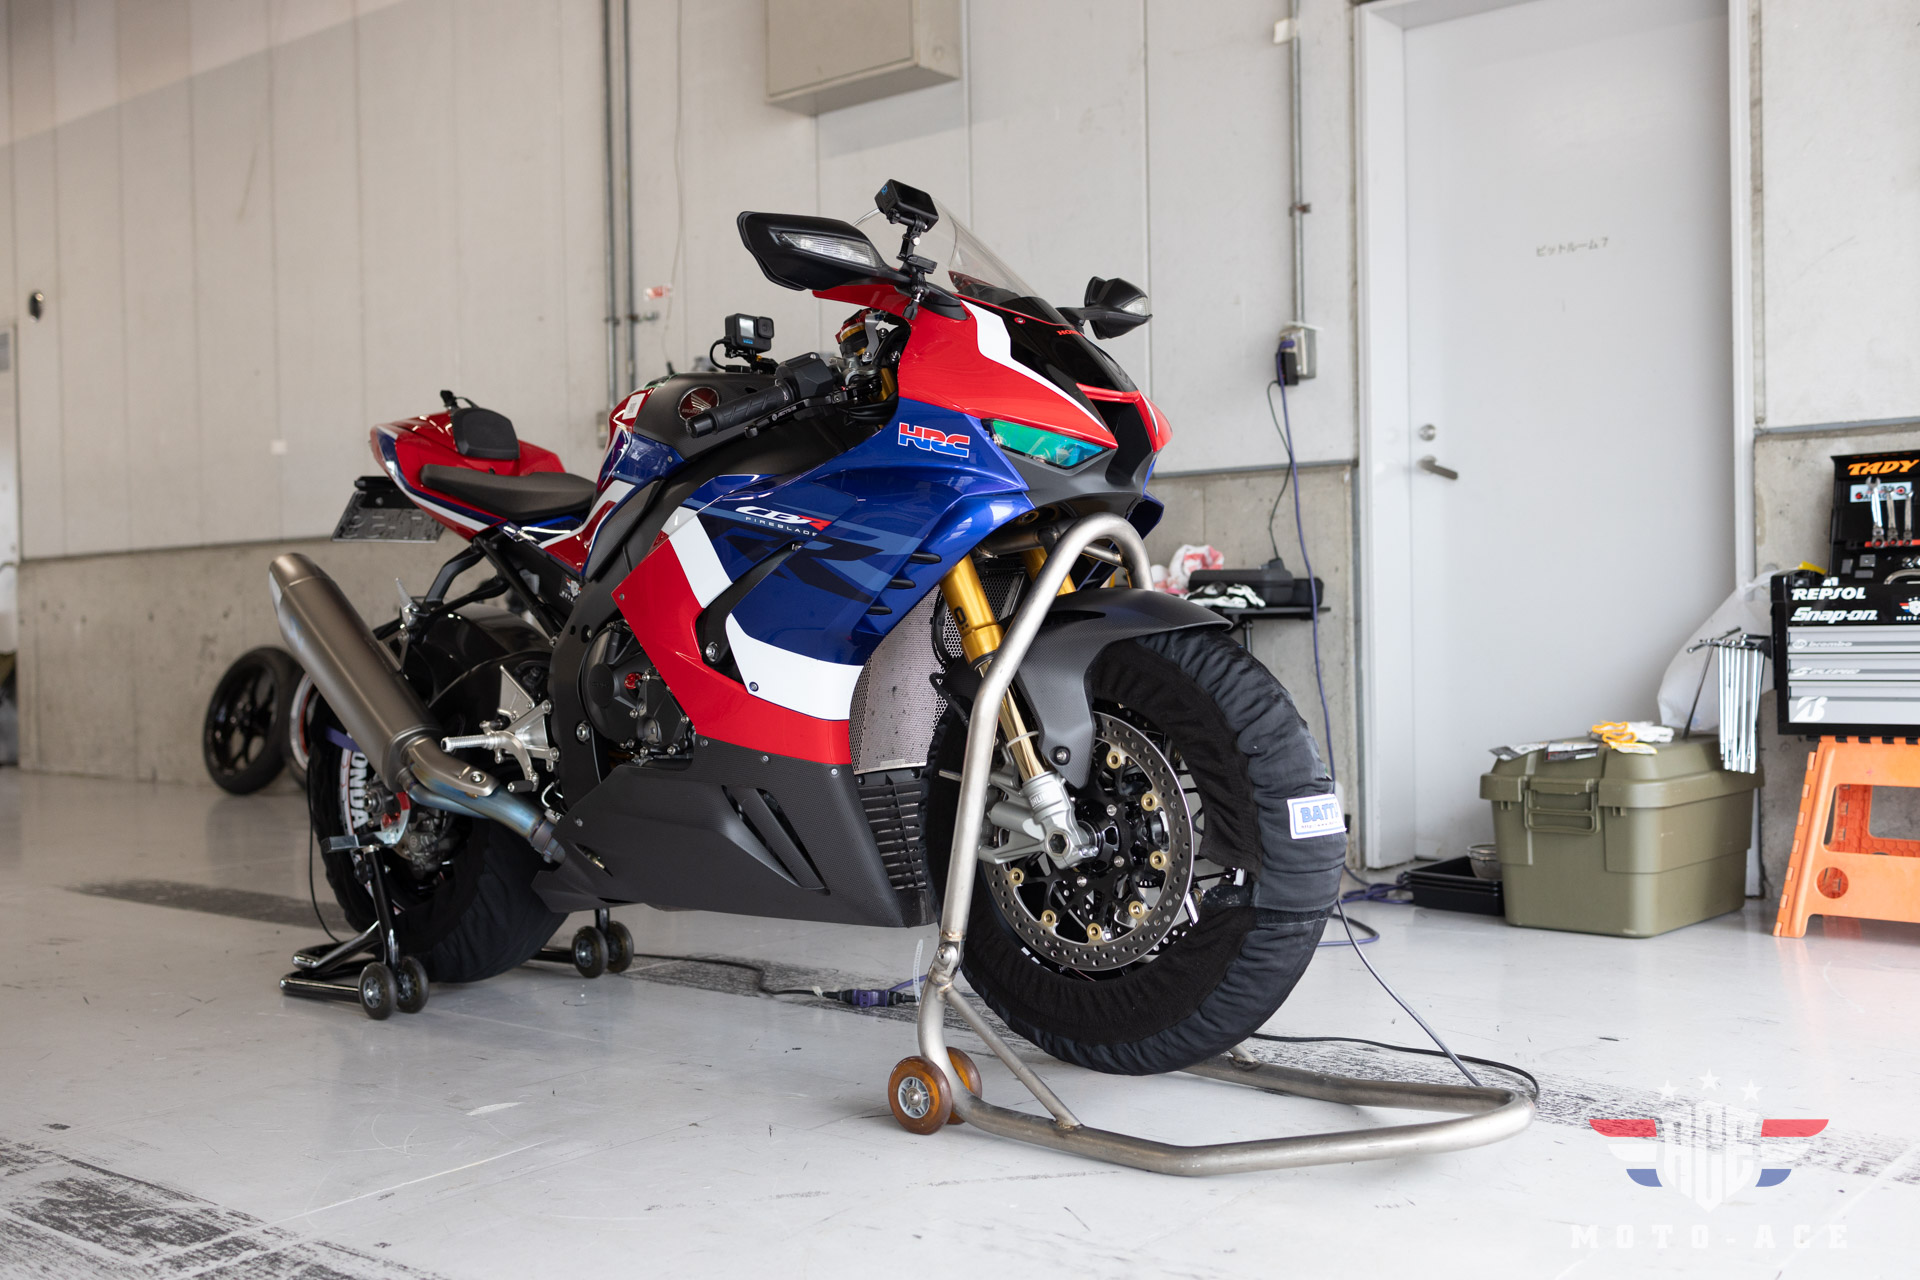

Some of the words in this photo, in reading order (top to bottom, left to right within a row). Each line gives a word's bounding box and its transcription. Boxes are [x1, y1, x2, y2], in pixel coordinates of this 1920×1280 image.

[898, 422, 971, 458] HRC
[1847, 459, 1920, 476] TADY
[745, 516, 818, 537] FIREBLADE
[1791, 587, 1866, 600] REPSOL
[349, 751, 369, 829] ONDA
